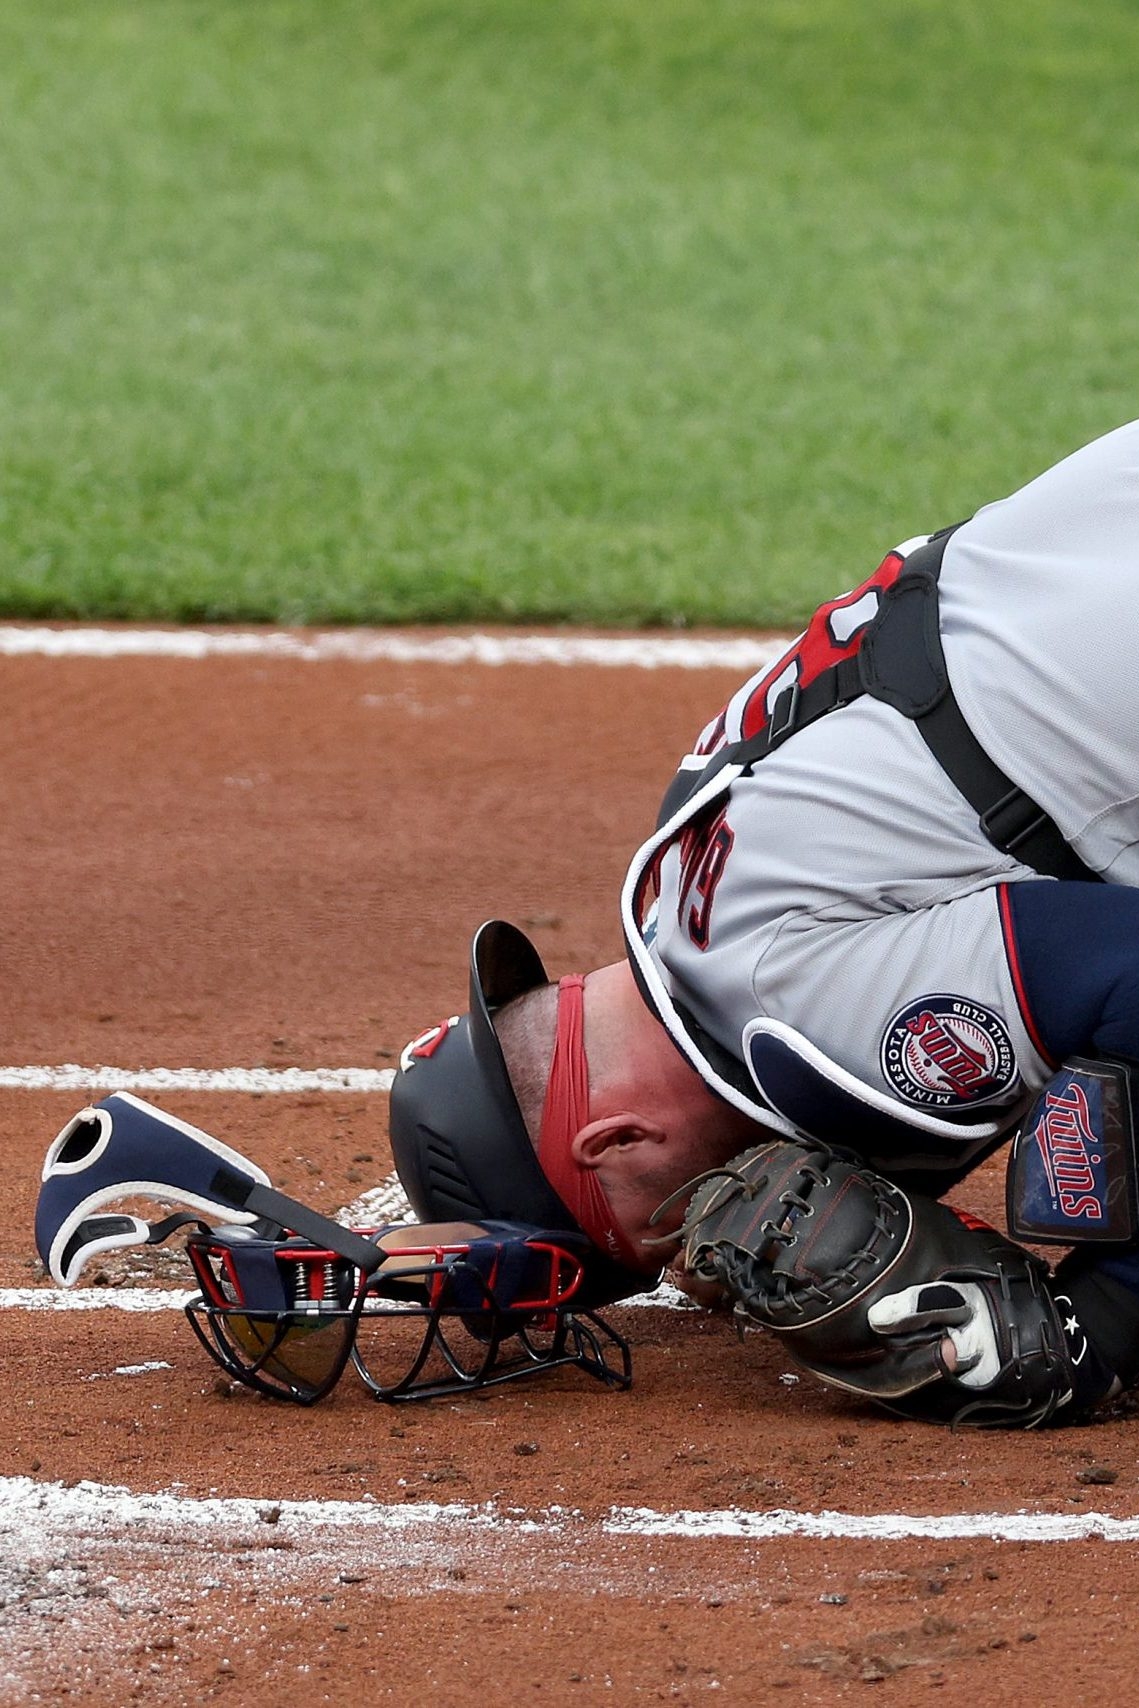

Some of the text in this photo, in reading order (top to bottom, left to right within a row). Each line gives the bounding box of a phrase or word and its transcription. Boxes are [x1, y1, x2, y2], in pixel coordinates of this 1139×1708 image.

[888, 1027, 951, 1104] MINNESOTA
[905, 1010, 998, 1099] Twins
[953, 1002, 1011, 1081] BASEBALL CLUB
[1043, 1083, 1102, 1219] Twins
